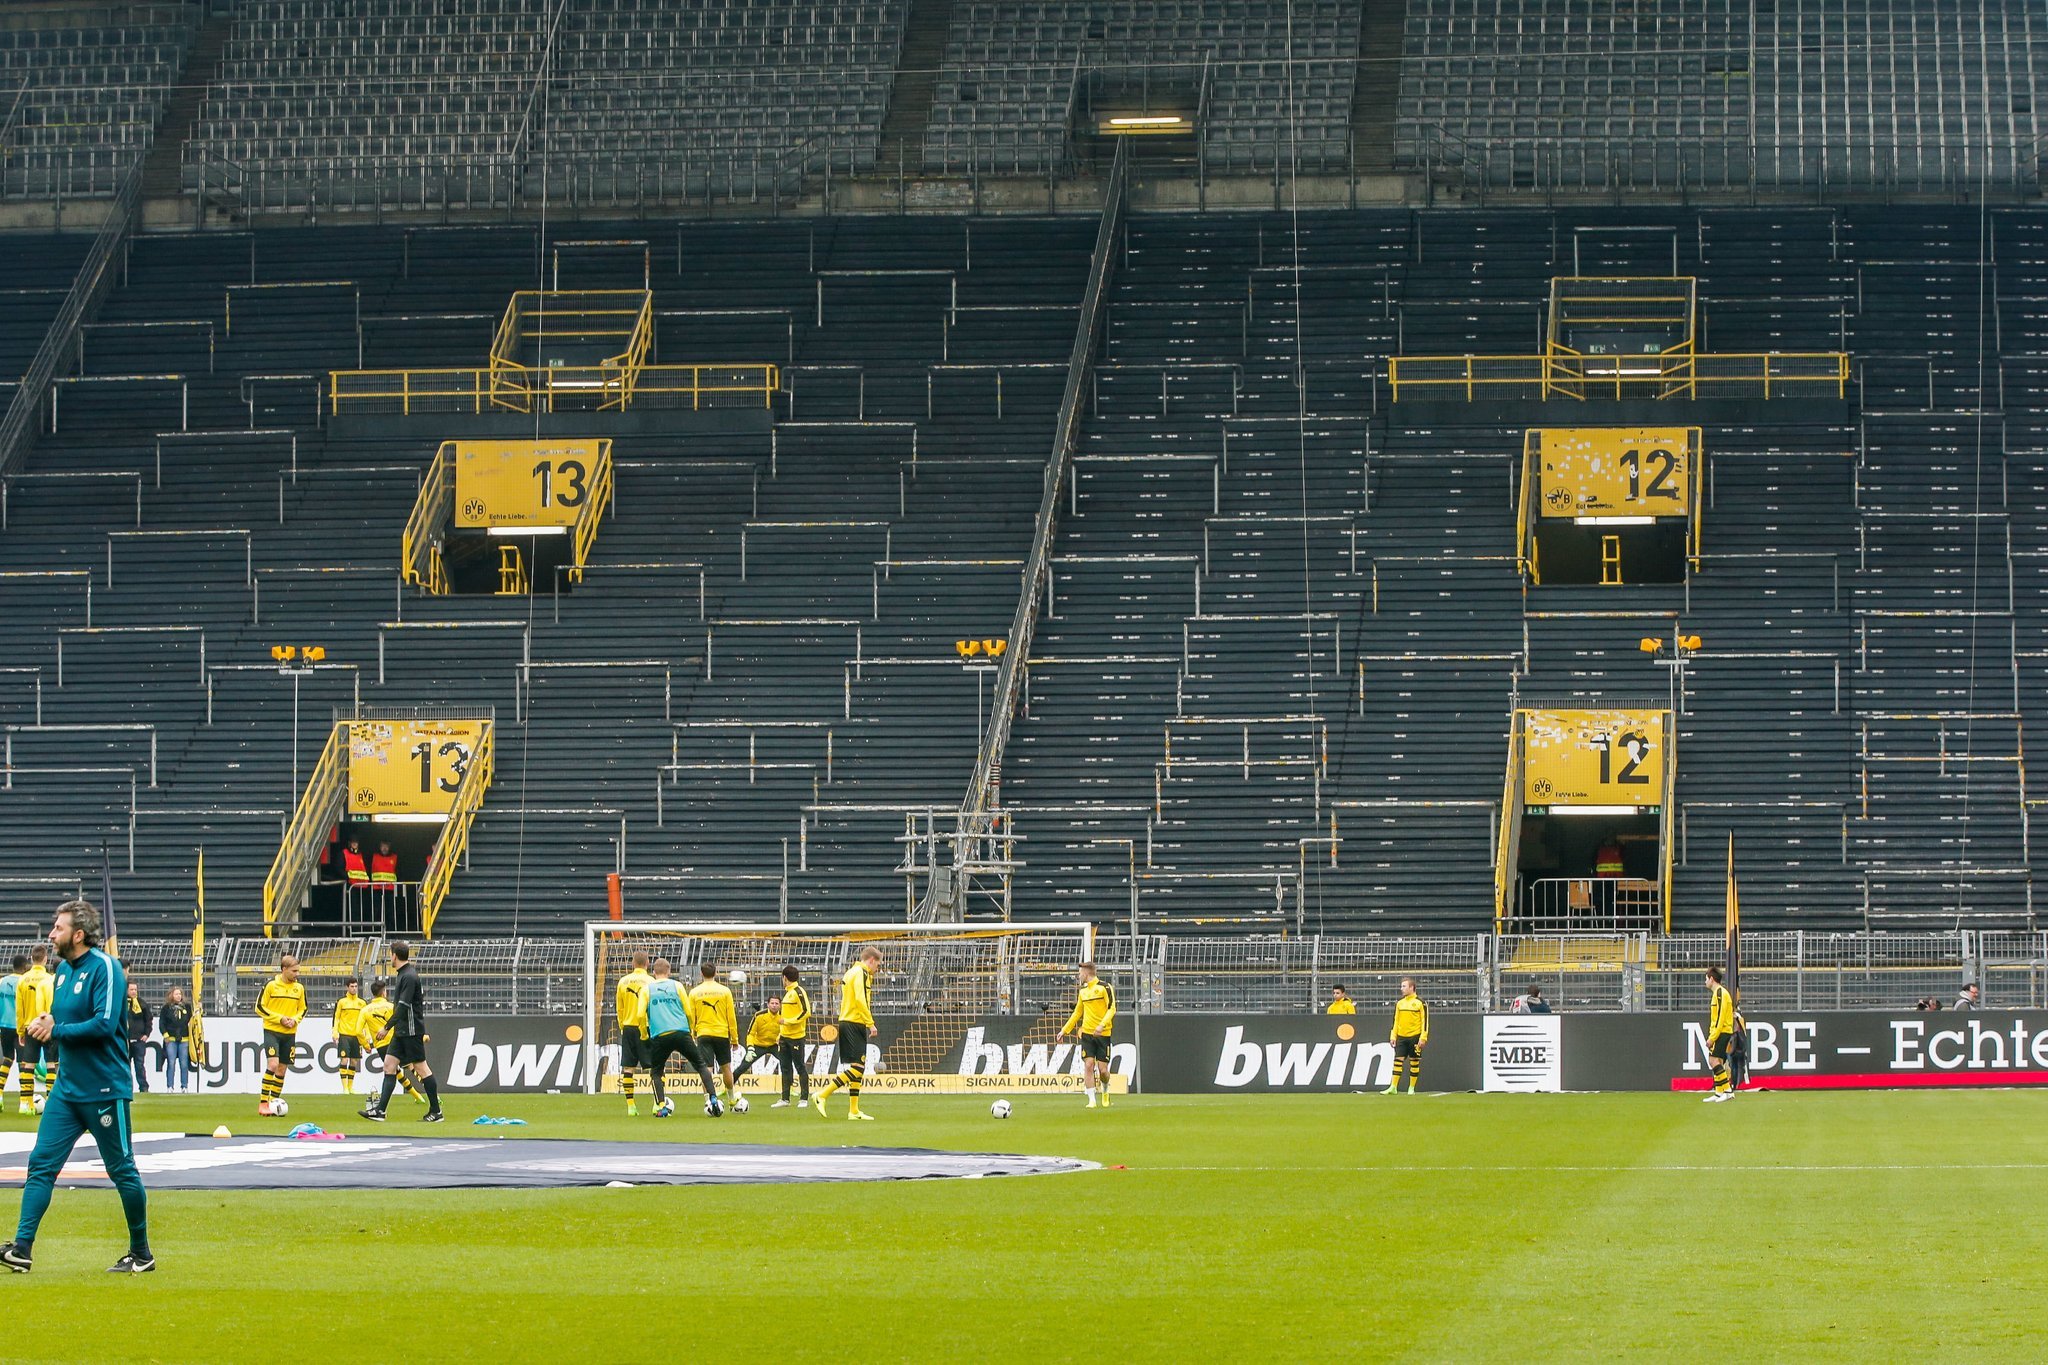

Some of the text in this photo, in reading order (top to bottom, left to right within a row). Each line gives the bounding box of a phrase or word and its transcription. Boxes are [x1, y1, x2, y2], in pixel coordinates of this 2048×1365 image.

[1619, 449, 1677, 498] 12
[532, 460, 587, 508] 13
[465, 500, 484, 515] BVB
[1590, 732, 1650, 784] 12
[411, 741, 469, 793] 13
[1534, 780, 1551, 793] BVB
[358, 789, 374, 802] BVB
[1213, 1025, 1396, 1087] bwin
[1497, 1047, 1546, 1064] MBE
[901, 1078, 936, 1087] PARK
[966, 1077, 1058, 1087] SIGNAL IDUNA
